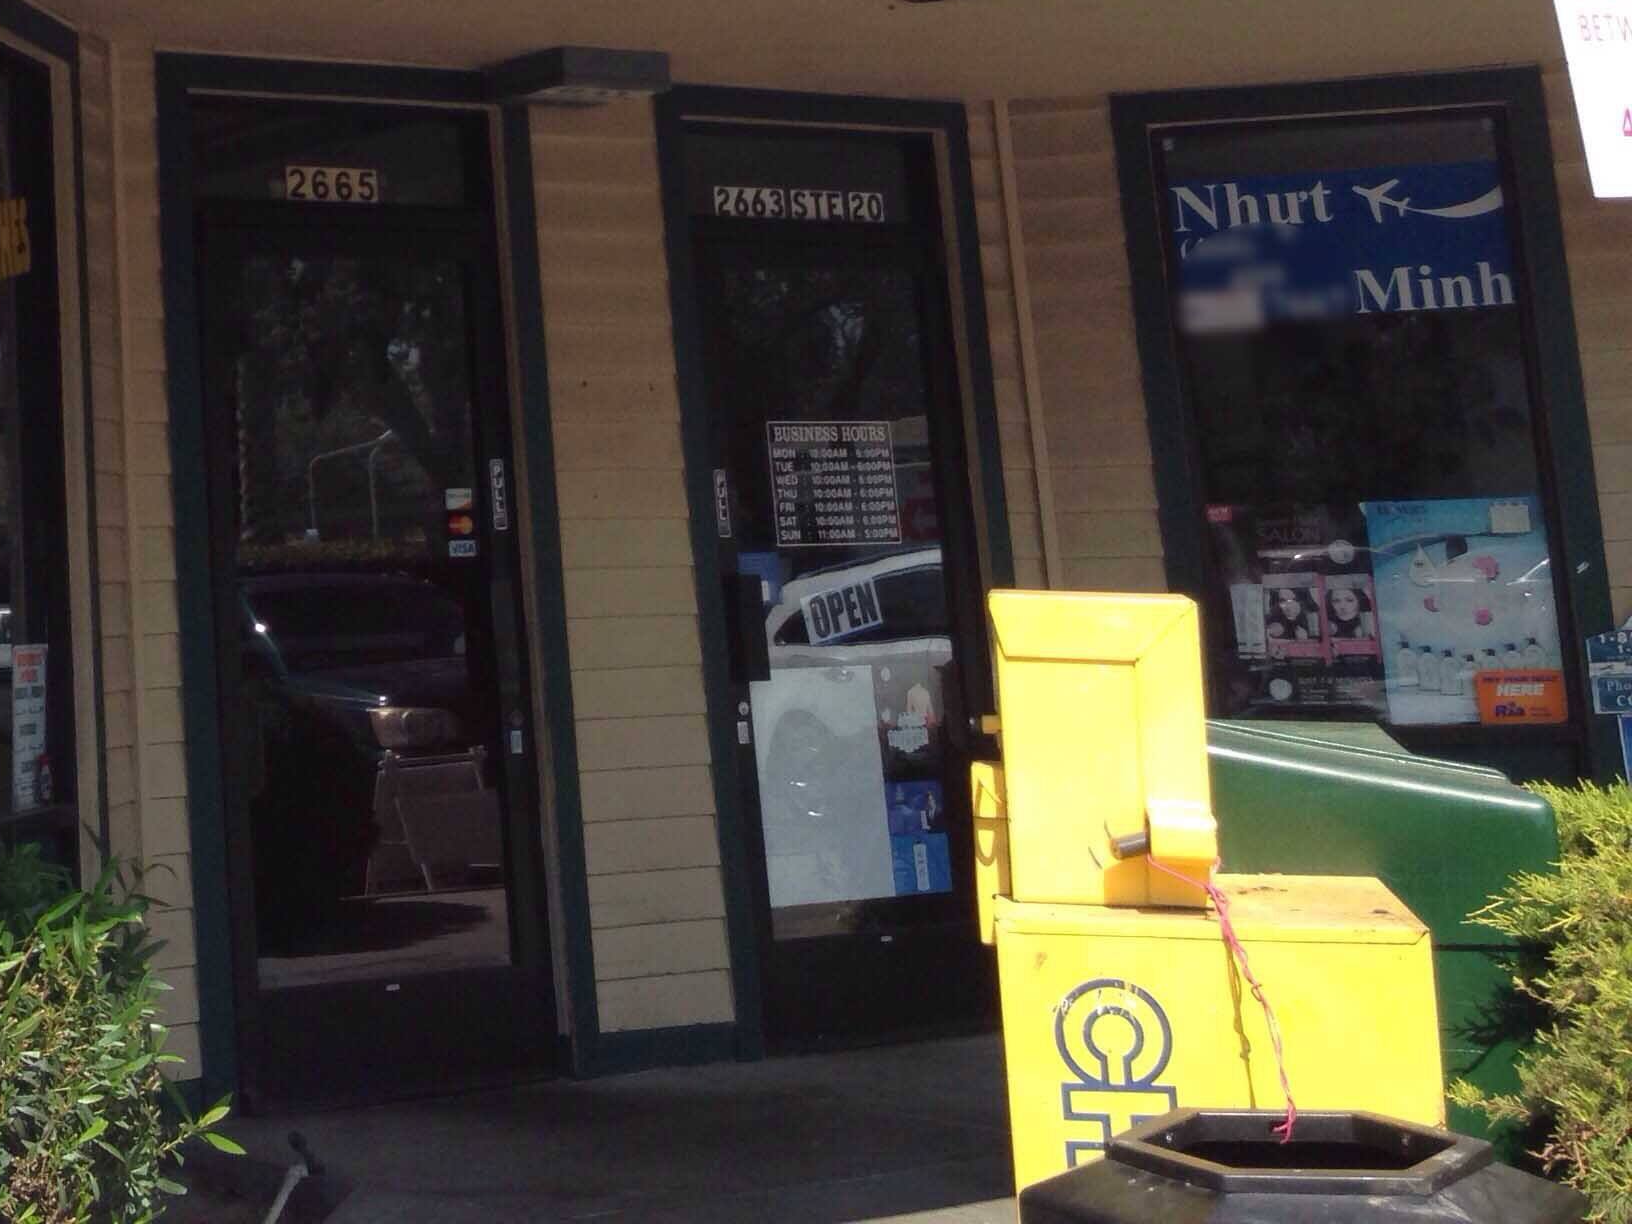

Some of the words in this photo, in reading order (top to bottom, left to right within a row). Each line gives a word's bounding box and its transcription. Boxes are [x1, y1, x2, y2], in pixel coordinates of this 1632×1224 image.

[288, 168, 377, 201] 2665
[715, 187, 784, 218] 2663
[791, 190, 843, 218] STE
[850, 193, 884, 220] 20
[1353, 261, 1517, 314] Minh
[773, 425, 839, 442] BUSINESS
[840, 425, 887, 442] HOURS
[772, 447, 796, 458] MON
[775, 461, 794, 472] TUE
[776, 474, 799, 486] WED
[777, 488, 798, 499] THU
[779, 502, 796, 513] FRI
[779, 516, 797, 527] SAT
[780, 530, 801, 541] SUN
[809, 582, 879, 638] OPEN
[1598, 631, 1632, 644] 1-8
